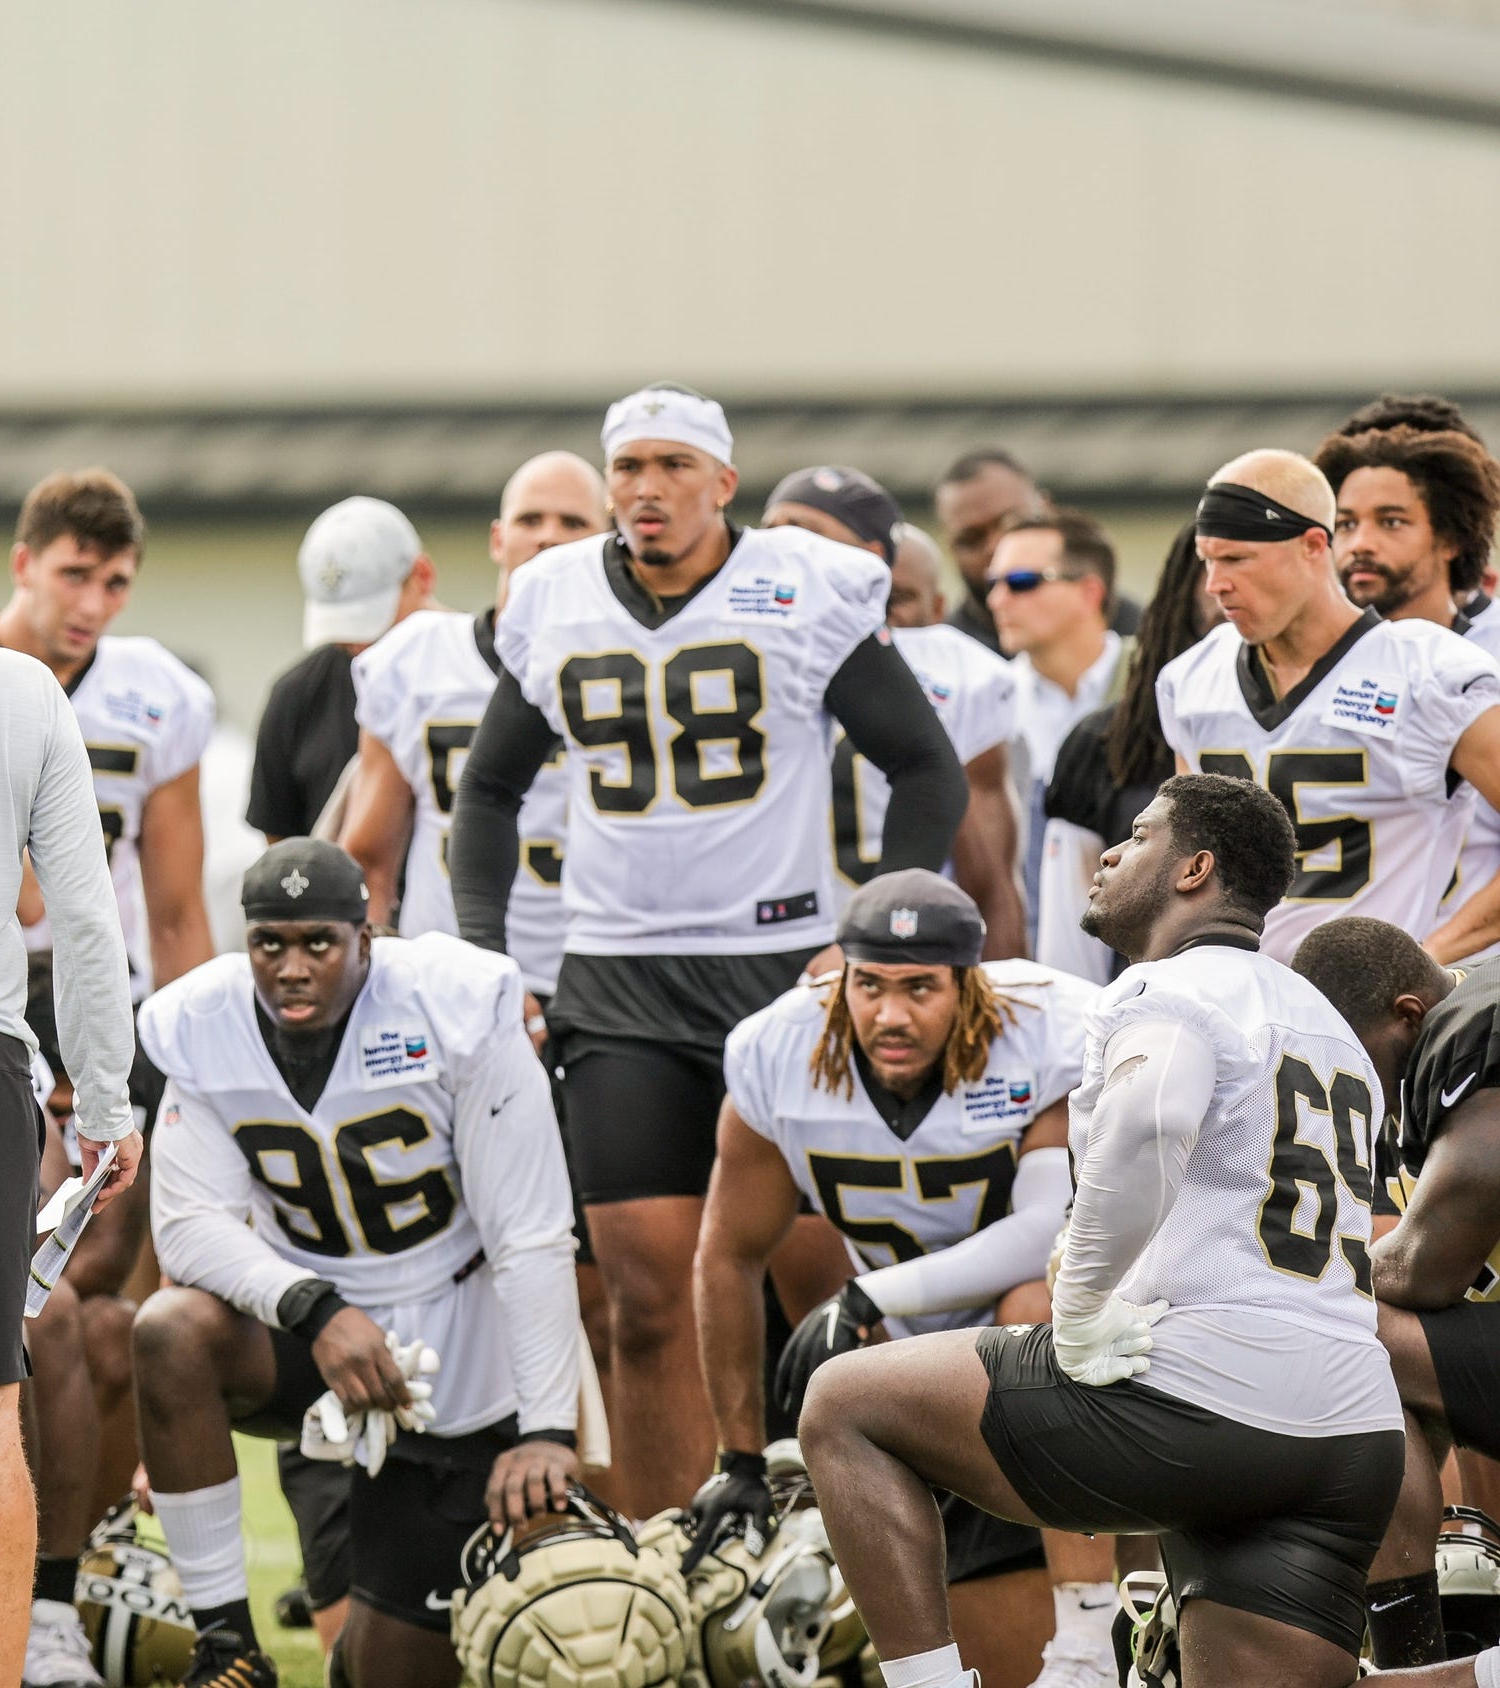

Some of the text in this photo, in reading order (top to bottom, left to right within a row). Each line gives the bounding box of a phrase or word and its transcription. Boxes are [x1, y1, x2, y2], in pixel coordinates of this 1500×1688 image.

[557, 639, 769, 816] 98
[1333, 698, 1370, 711] energy
[1337, 686, 1374, 699] human
[1361, 680, 1378, 689] the
[1199, 748, 1375, 903] 5
[230, 1103, 460, 1258] 96
[805, 1139, 1018, 1271] 57
[1255, 1051, 1374, 1302] 69
